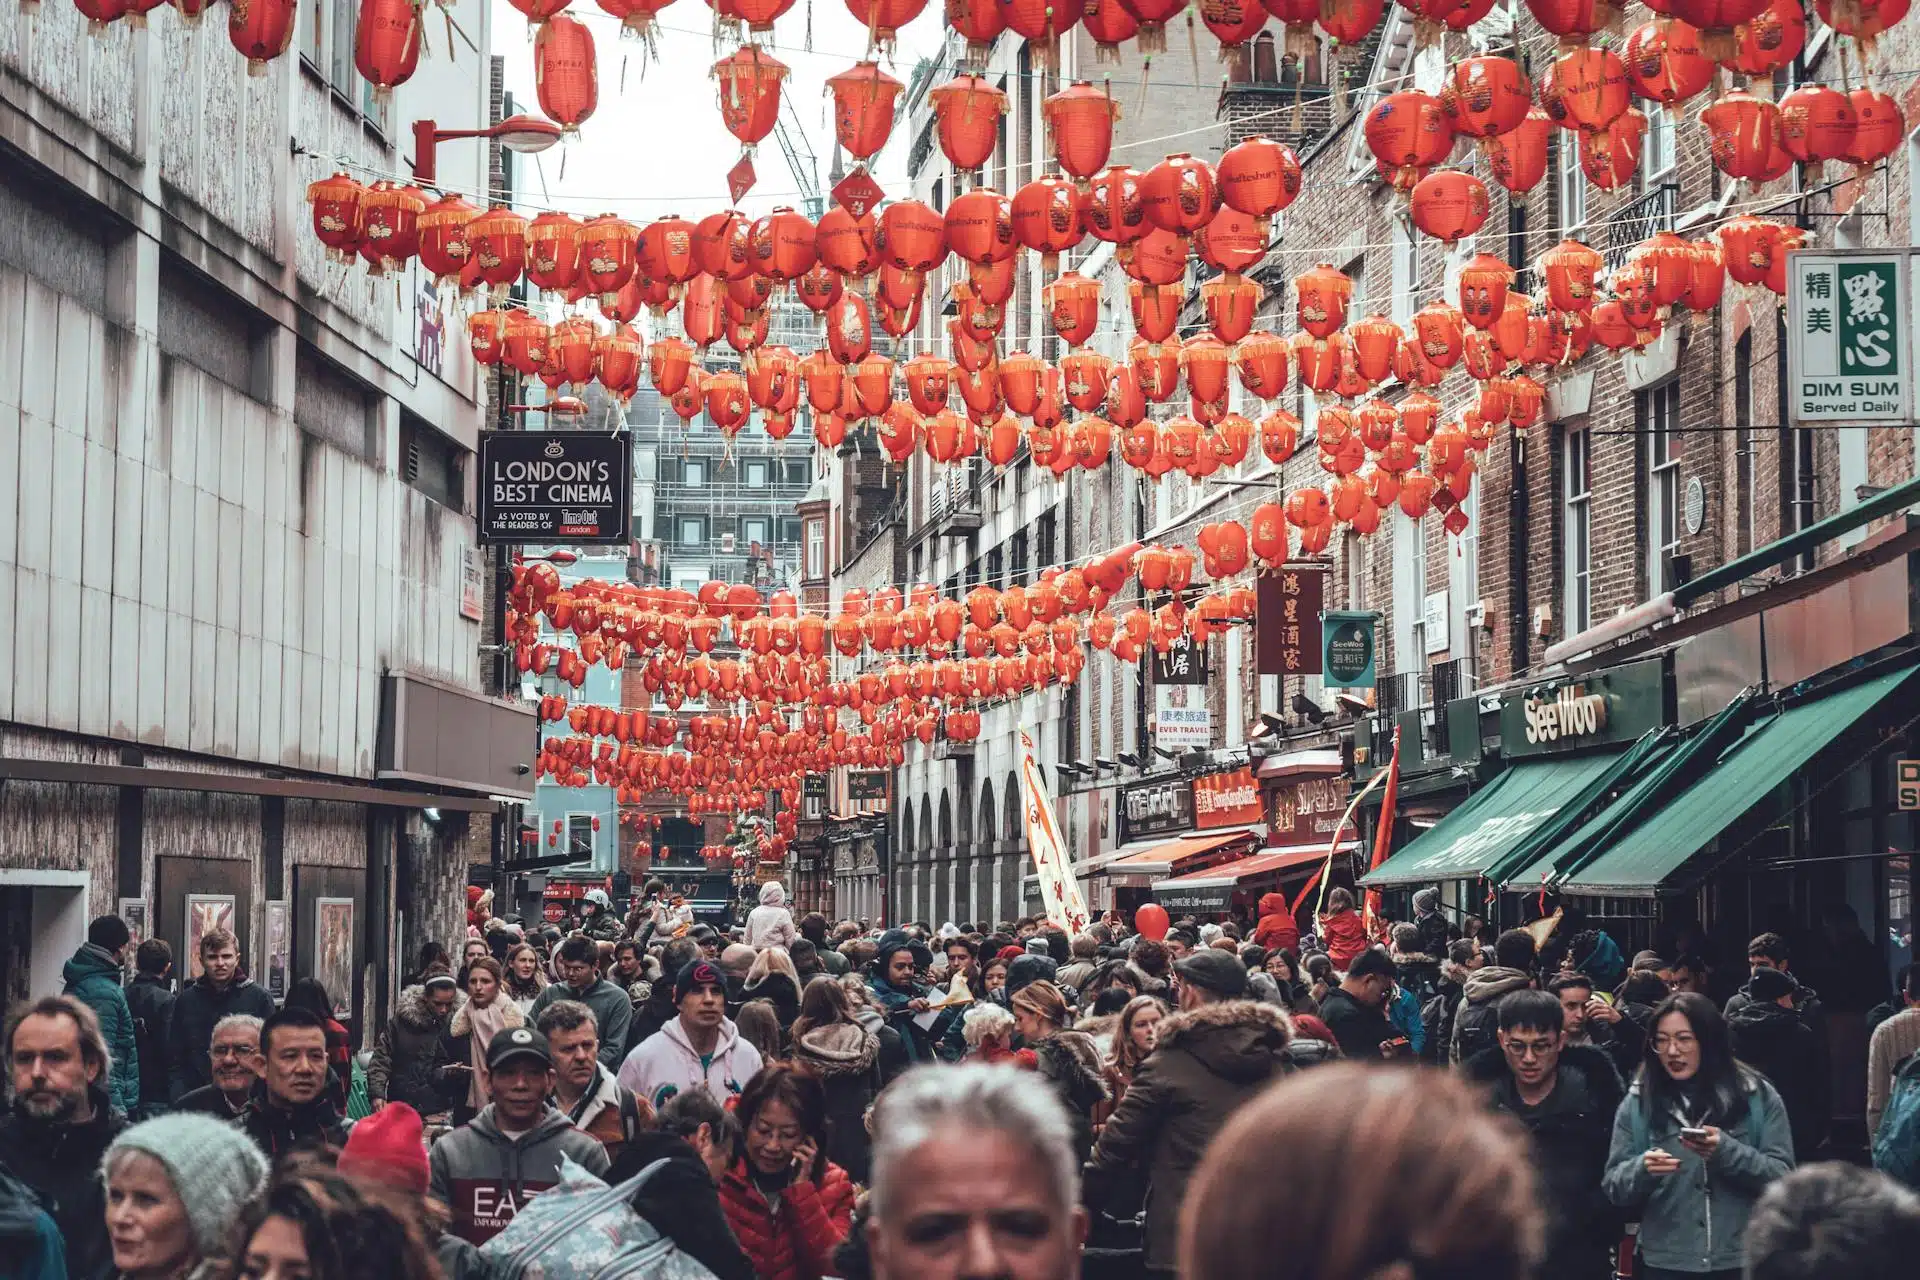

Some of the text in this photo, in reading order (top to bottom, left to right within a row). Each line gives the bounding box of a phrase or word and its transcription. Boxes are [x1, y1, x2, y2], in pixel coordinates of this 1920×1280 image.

[1805, 272, 1832, 334] 精美
[1803, 382, 1899, 397] DIM SUM
[1803, 401, 1899, 414] Served Daily
[494, 459, 609, 482] LONDON'S
[494, 484, 613, 503] BEST CINEMA
[498, 512, 550, 521] AS VOTED BY
[492, 521, 553, 529] THE READERS OF
[1159, 726, 1208, 734] EVER TRAVEL
[682, 883, 700, 897] 97
